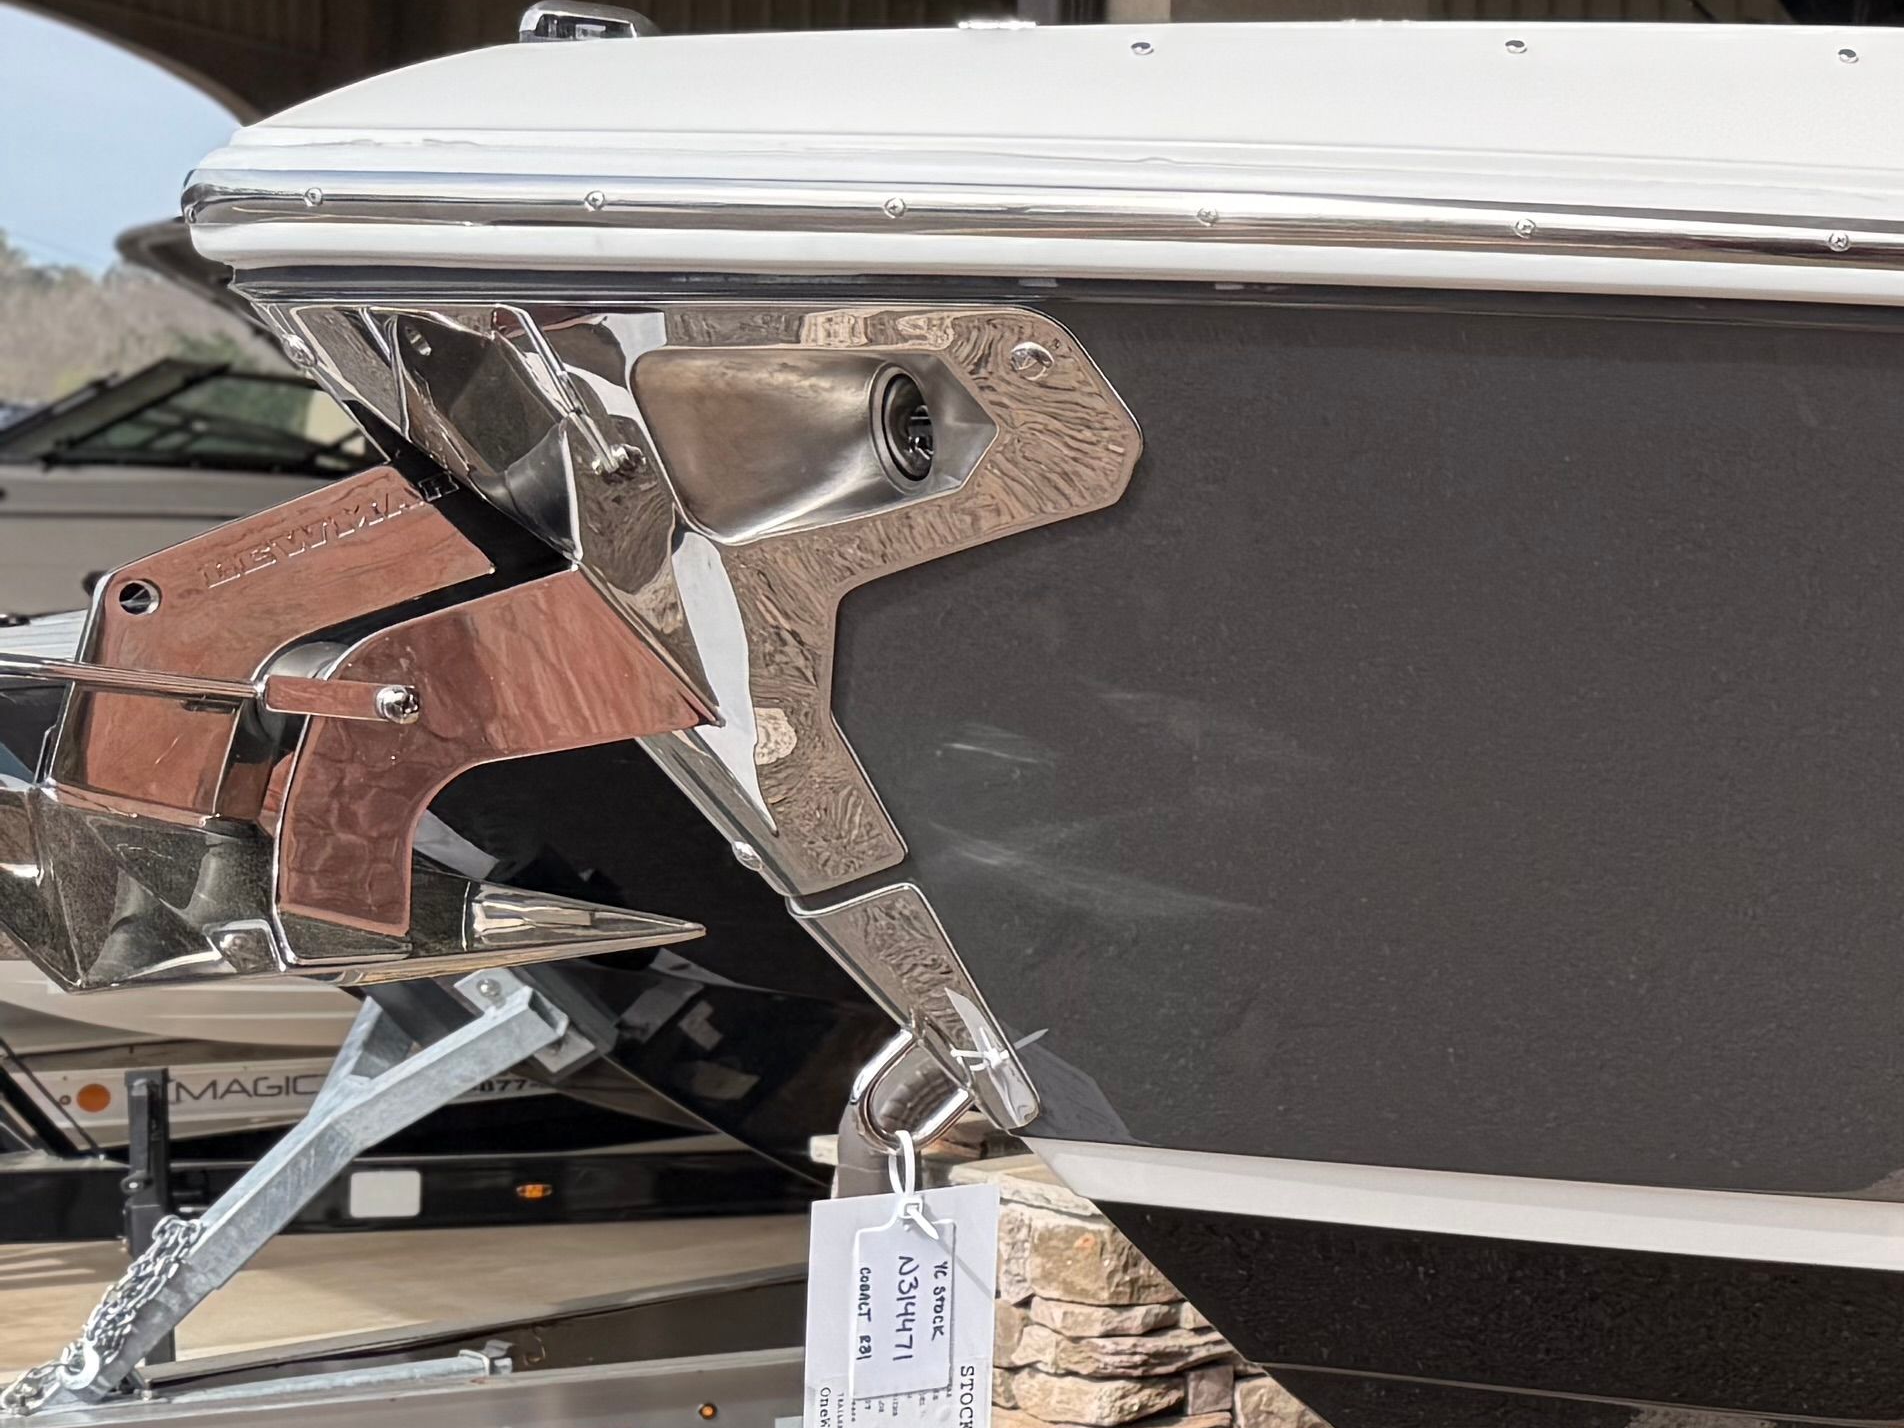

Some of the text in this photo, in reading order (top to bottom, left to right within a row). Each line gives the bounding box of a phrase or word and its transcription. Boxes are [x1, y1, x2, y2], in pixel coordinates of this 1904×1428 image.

[175, 1074, 329, 1100] MAGIC
[857, 1266, 871, 1323] COBALT
[891, 1255, 919, 1362] N314471
[930, 1286, 946, 1342] STOCK
